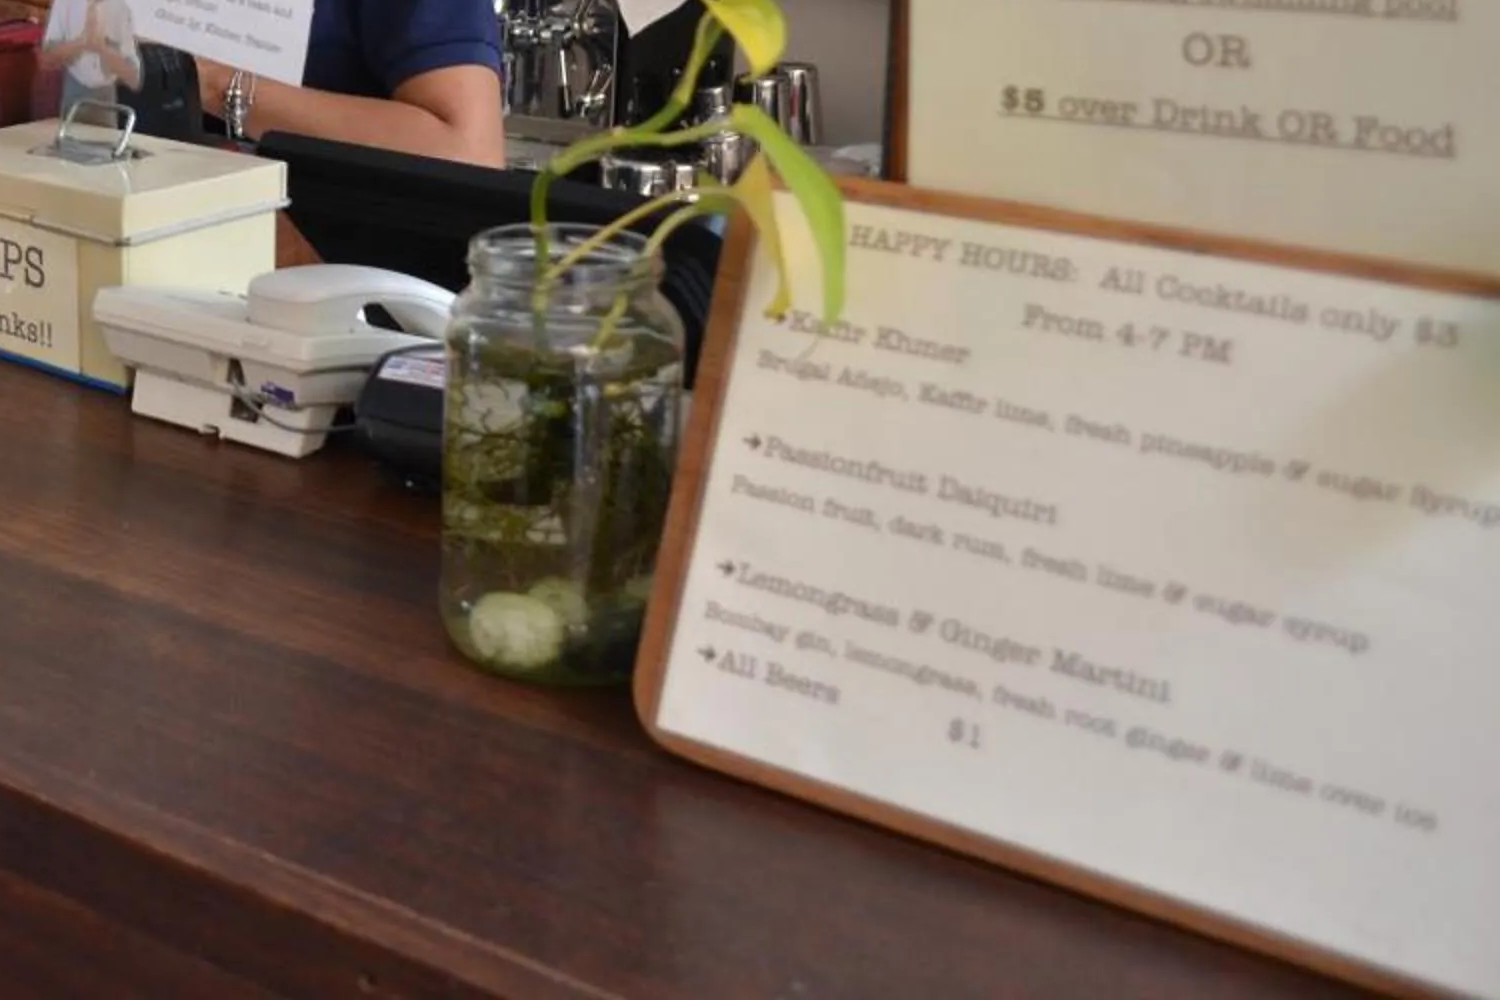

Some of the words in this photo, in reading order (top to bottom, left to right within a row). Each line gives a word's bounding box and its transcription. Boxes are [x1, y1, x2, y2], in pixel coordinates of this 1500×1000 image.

[1182, 35, 1251, 69] OR
[1001, 85, 1044, 112] $5
[1057, 96, 1136, 124] over
[1153, 98, 1259, 136] Drink
[1277, 110, 1337, 141] OR
[1352, 115, 1456, 156] Food
[848, 224, 950, 264] HAPPY
[959, 240, 1079, 283] HOURS:
[1098, 265, 1145, 295] All
[1155, 273, 1308, 324] Cocktails
[1319, 303, 1401, 347] only
[1414, 315, 1459, 348] $3
[873, 322, 971, 364] Khmer
[1021, 302, 1105, 341] From
[1116, 322, 1169, 351] 4-7
[1179, 332, 1235, 364] PM
[763, 435, 927, 493] Passionfruit
[937, 474, 1058, 526] Daiquiri
[918, 381, 988, 419] Kaffir
[997, 396, 1055, 434] lime,
[1065, 410, 1131, 448] fresh
[1140, 429, 1276, 481] pineapple
[1282, 458, 1311, 482] &
[1316, 468, 1401, 503] sugar
[731, 472, 816, 514] Passion
[822, 495, 881, 532] fruit,
[889, 513, 945, 546] dark
[952, 532, 1011, 565] rum,
[1020, 547, 1088, 582] fresh
[1096, 562, 1155, 598] lime
[1162, 581, 1189, 605] &
[1193, 592, 1276, 627] sugar
[1283, 614, 1370, 655] syrup
[736, 559, 900, 628] Lemongrass
[907, 609, 935, 635] &
[939, 617, 1042, 666] Ginger
[1049, 647, 1172, 703] Martini
[703, 600, 790, 644] Bombay
[794, 628, 837, 659] gin,
[844, 638, 983, 702] lemongrass,
[991, 684, 1057, 721] fresh
[1064, 706, 1117, 739] root
[1124, 724, 1211, 762] ginger
[1218, 750, 1244, 773] &
[1250, 758, 1313, 797] lime
[1319, 783, 1386, 817] over
[716, 648, 757, 680] All
[764, 662, 841, 704] Beers
[947, 716, 981, 750] $1
